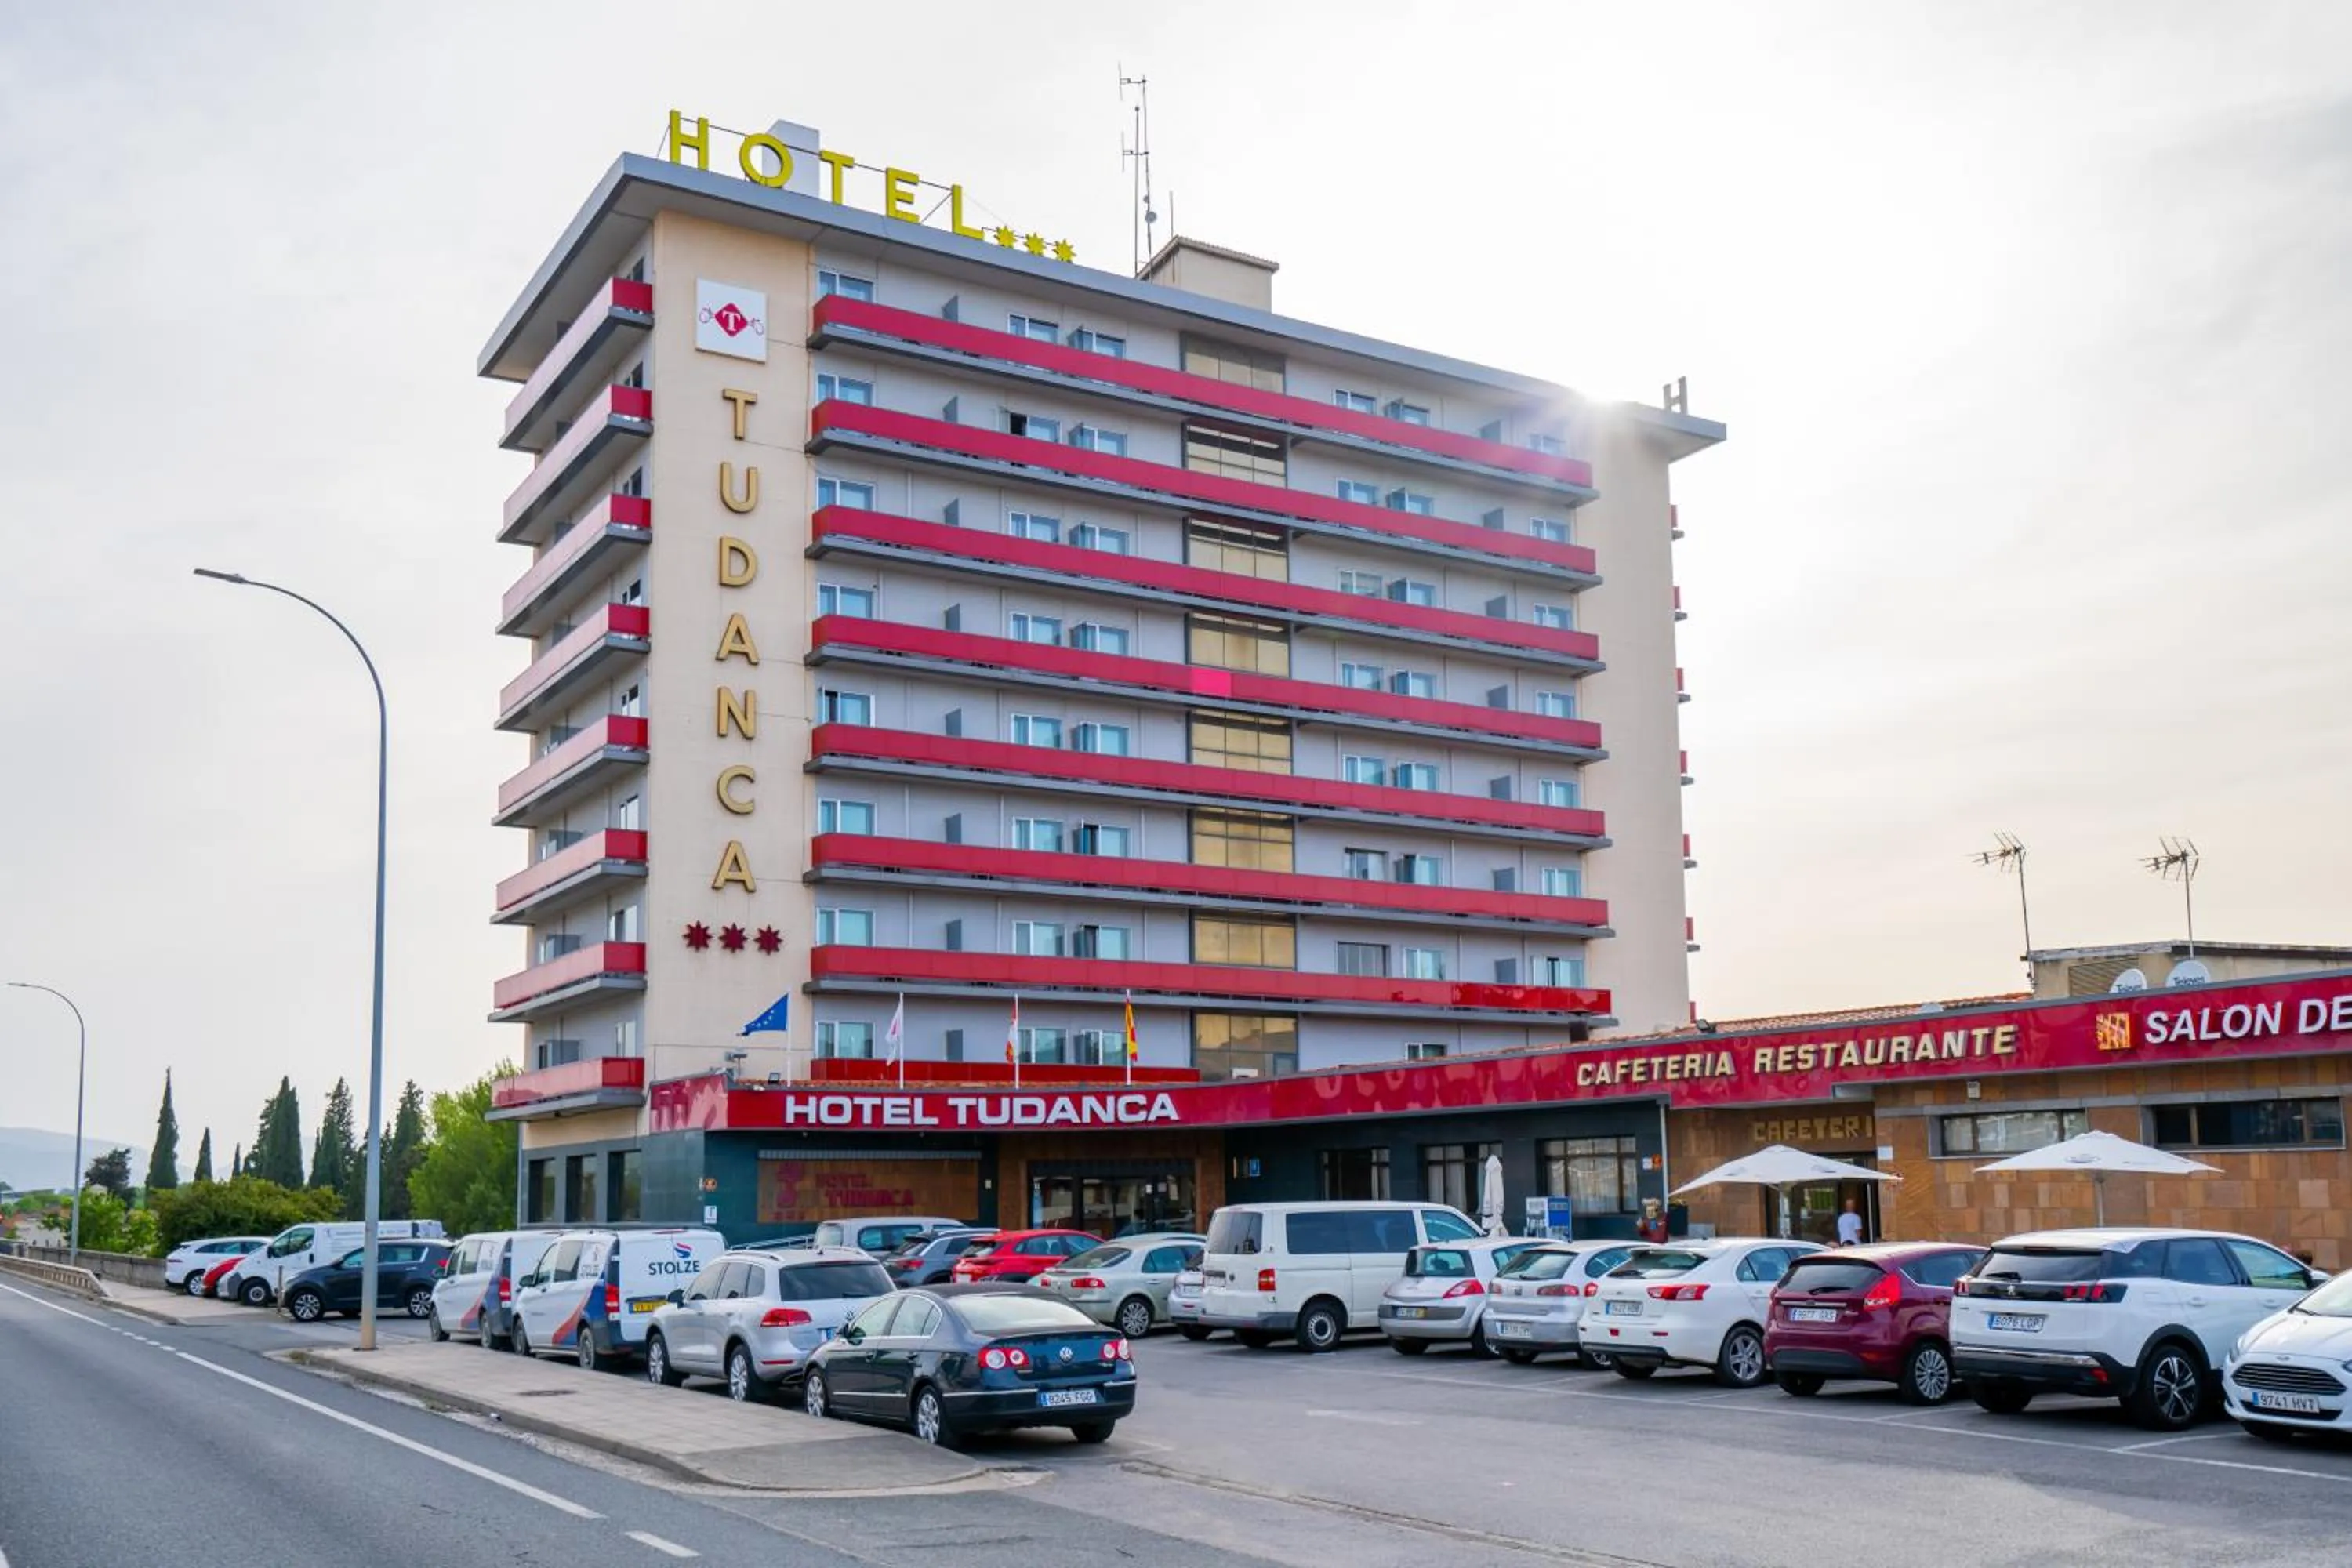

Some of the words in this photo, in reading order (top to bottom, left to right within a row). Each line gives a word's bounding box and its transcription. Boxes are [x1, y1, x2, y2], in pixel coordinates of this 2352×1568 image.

[669, 110, 984, 241] HOTEL
[722, 310, 742, 332] T
[712, 388, 760, 892] TUDANCA
[2145, 1000, 2283, 1044] SALON
[1577, 1051, 1735, 1086] CAFETERIA
[1754, 1024, 2017, 1073] RESTAURANTE
[785, 1095, 938, 1125] HOTEL
[948, 1093, 1179, 1125] TUDANCA
[648, 1260, 700, 1276] STOLZE
